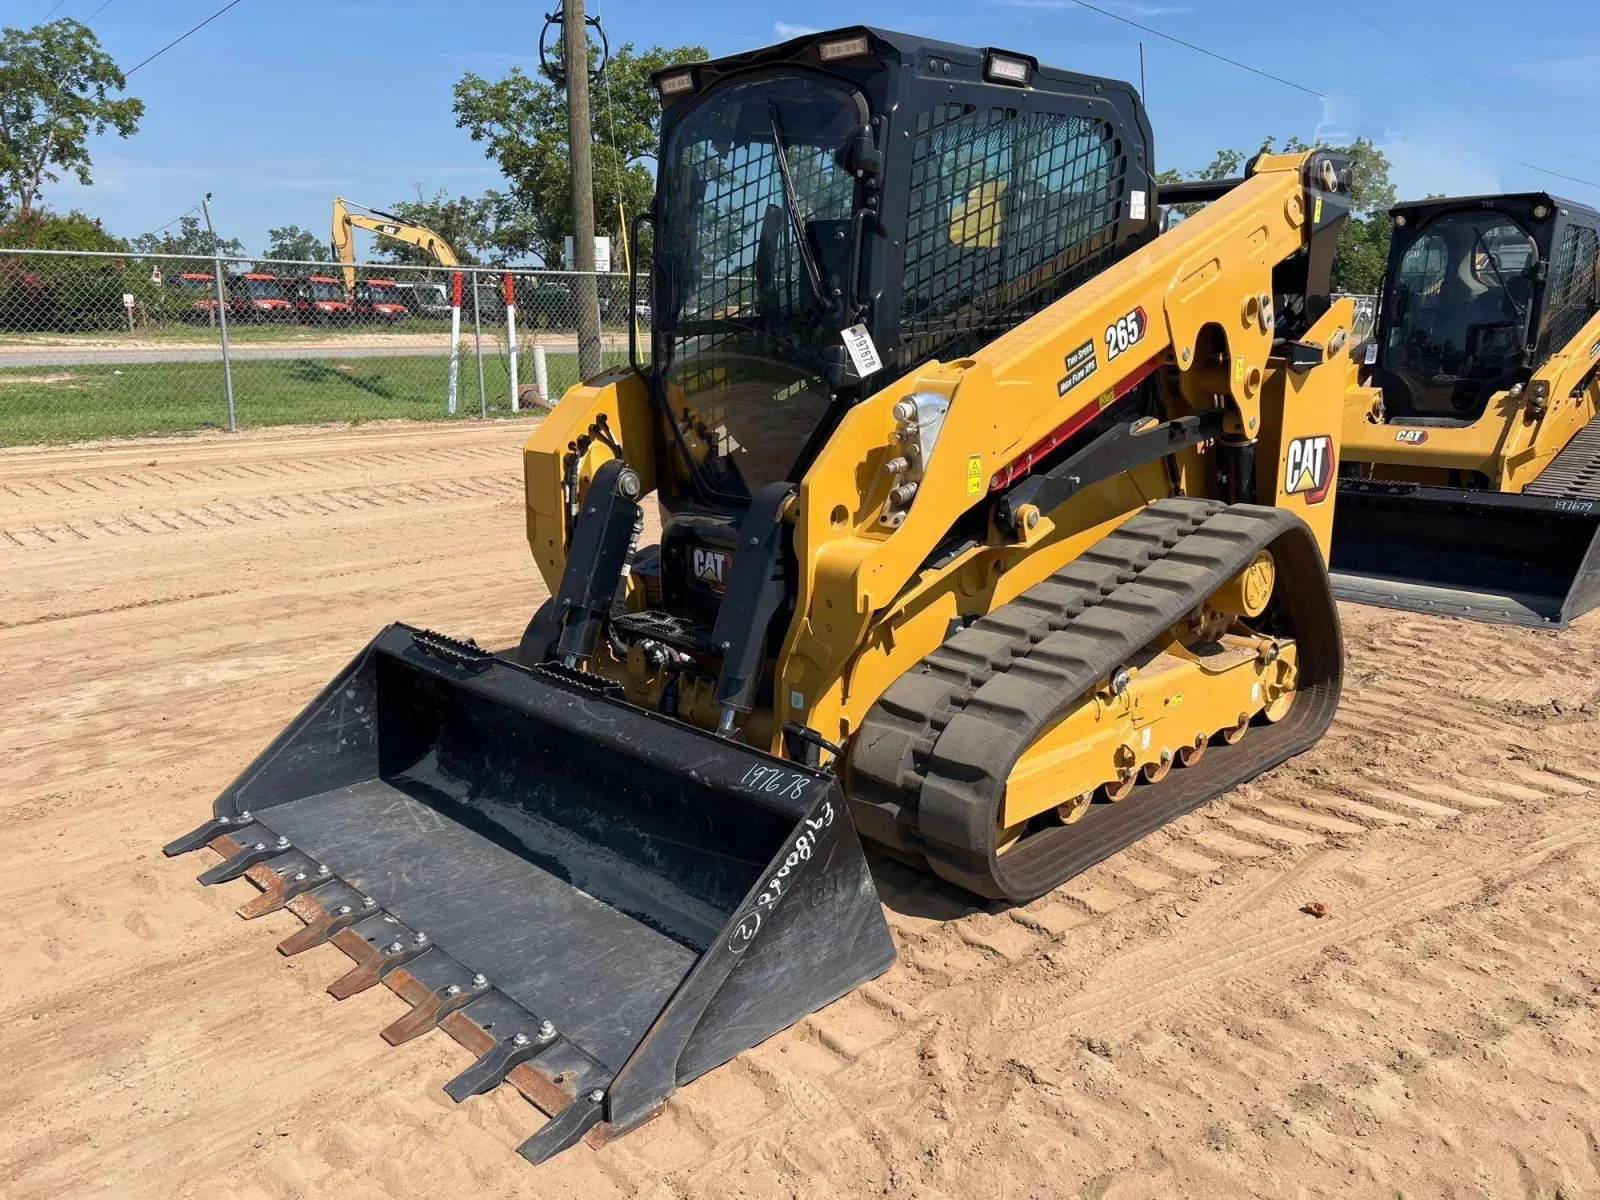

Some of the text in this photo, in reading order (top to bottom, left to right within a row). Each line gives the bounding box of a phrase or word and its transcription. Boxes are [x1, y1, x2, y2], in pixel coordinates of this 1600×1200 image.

[383, 225, 396, 235] CAT
[854, 334, 876, 368] 197678
[1106, 311, 1138, 360] 265
[1395, 430, 1424, 442] CAT
[1286, 437, 1327, 493] CAT
[1555, 500, 1593, 511] 197679
[693, 549, 725, 583] CAT
[741, 763, 811, 799] 197678
